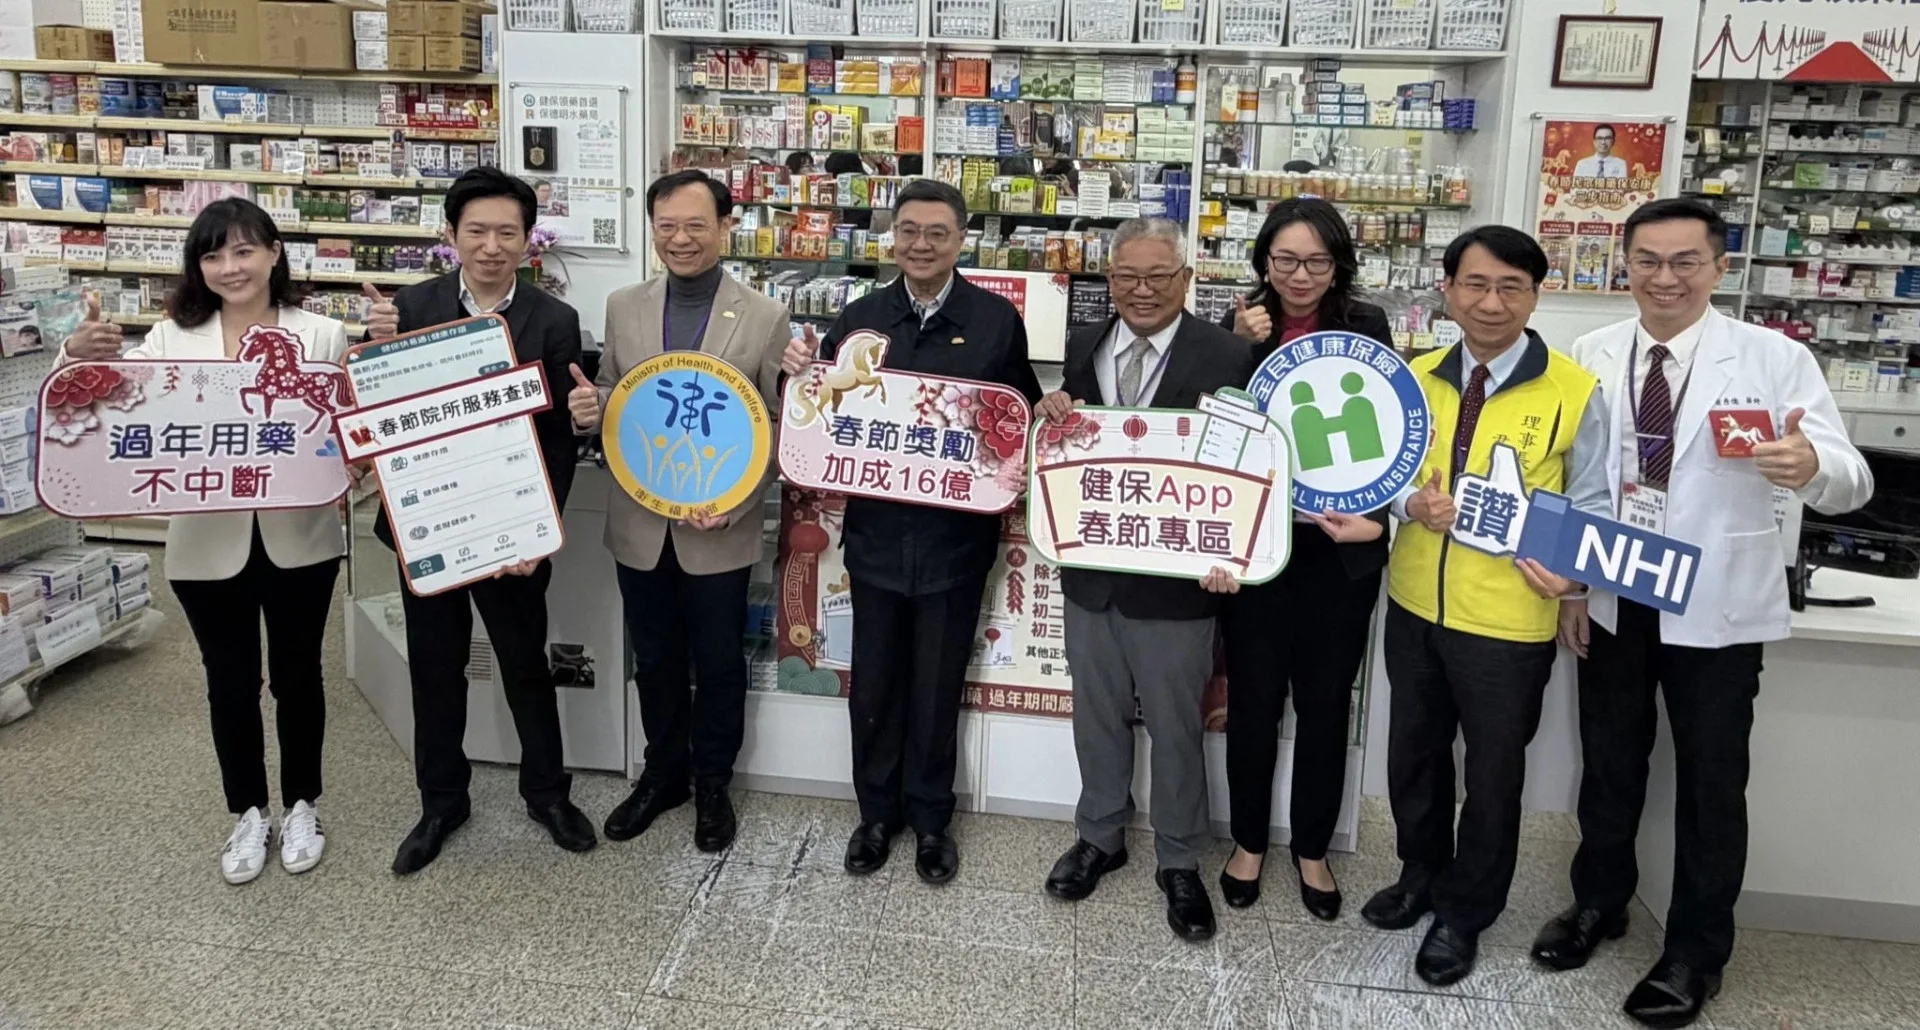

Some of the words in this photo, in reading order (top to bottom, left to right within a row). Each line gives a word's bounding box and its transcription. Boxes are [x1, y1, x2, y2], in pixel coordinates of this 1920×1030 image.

[622, 363, 660, 392] Ministry
[662, 357, 674, 368] of
[677, 356, 714, 372] Health
[715, 366, 738, 384] and
[736, 382, 762, 424] Welfare
[1251, 336, 1401, 403] 全民健康保險
[377, 379, 542, 438] 春節院所服務查詢
[109, 421, 296, 460] 過年用藥
[829, 414, 976, 463] 春節獎勵
[1313, 490, 1378, 510] HEALTH
[1379, 407, 1423, 496] INSURANCE
[131, 464, 272, 503] 不中斷
[634, 486, 718, 517] 衛生福利部
[821, 453, 975, 502] 加成16億
[1079, 466, 1233, 514] 健保App
[1077, 509, 1233, 556] 春節專區
[1455, 481, 1519, 547] 讚
[1574, 523, 1694, 604] NHI
[1031, 621, 1063, 639] 初三
[1032, 603, 1064, 620] 初二
